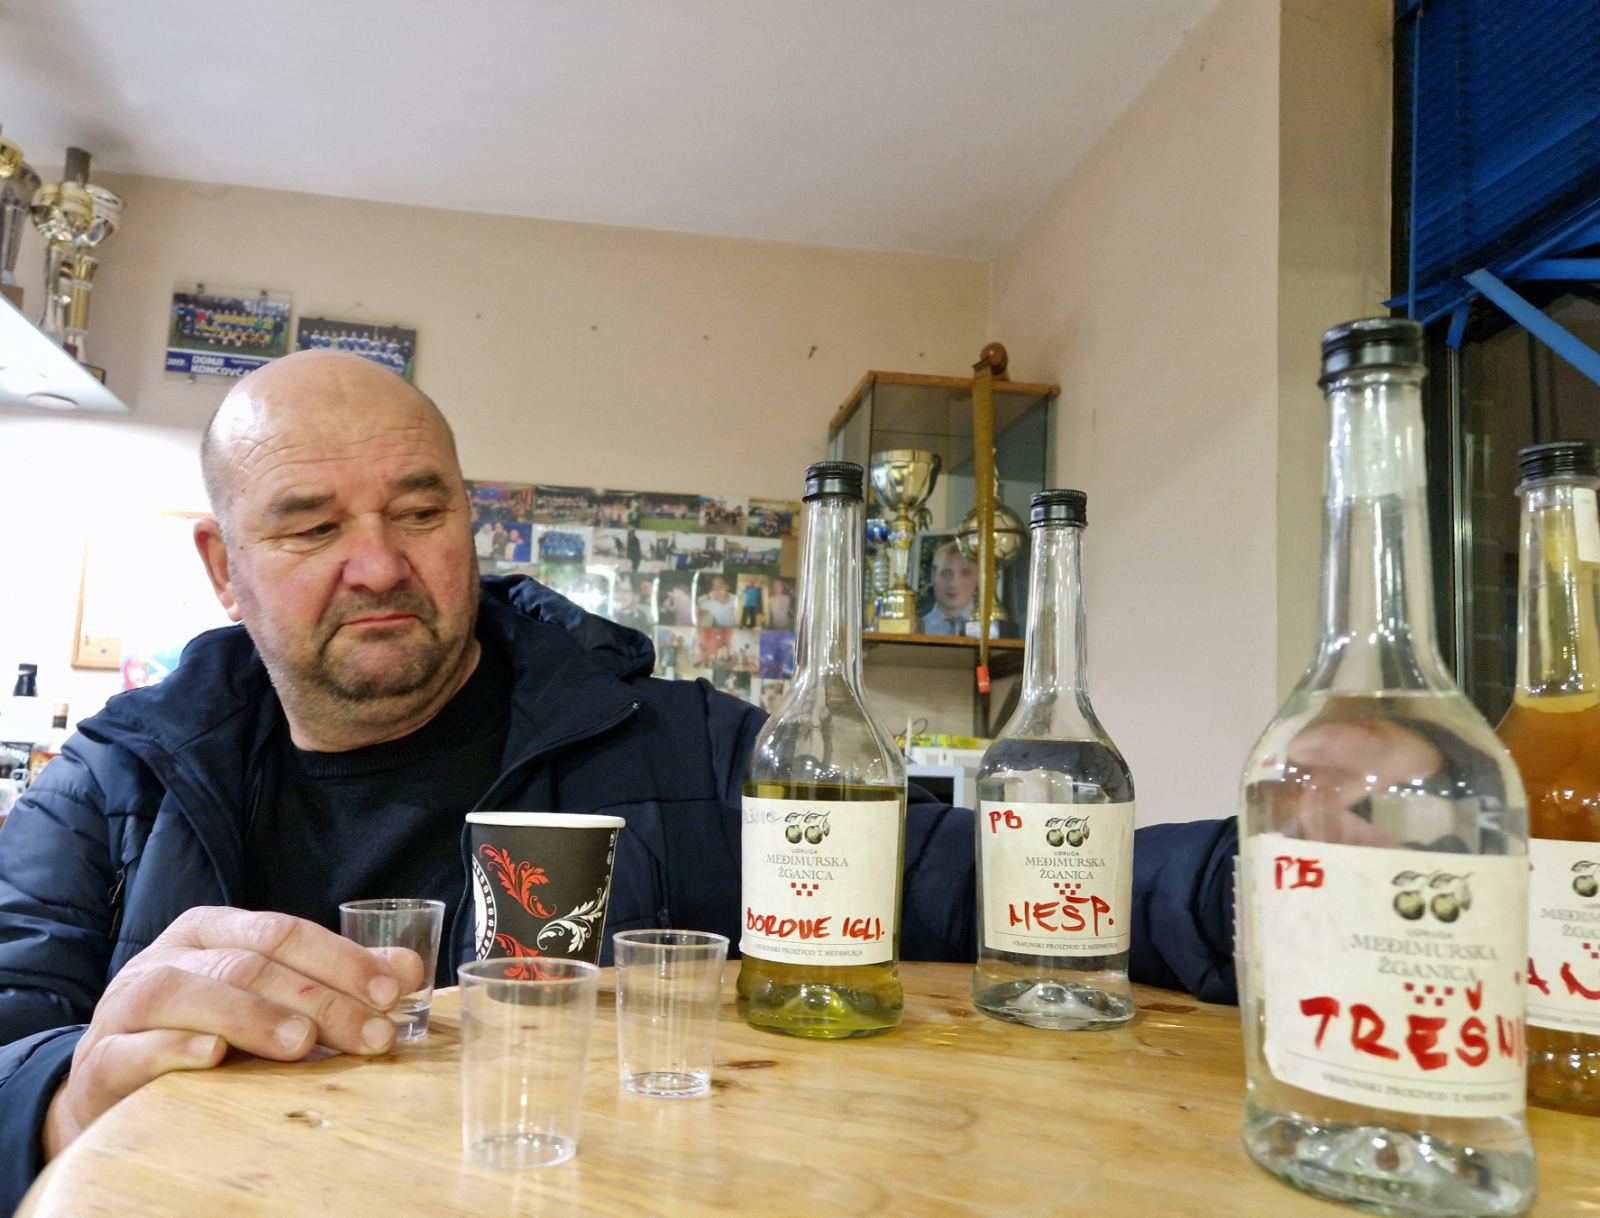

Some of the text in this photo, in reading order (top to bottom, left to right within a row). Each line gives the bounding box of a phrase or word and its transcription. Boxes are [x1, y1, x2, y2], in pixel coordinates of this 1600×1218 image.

[766, 854, 849, 868] MEĐIMURSKA
[1025, 856, 1106, 868] MEĐIMURSKA
[778, 866, 834, 881] ŽGANICA
[1040, 868, 1094, 880] ŽGANICA
[1350, 934, 1498, 961] MEĐIMURSKA
[1377, 955, 1478, 982] ŽGANICA
